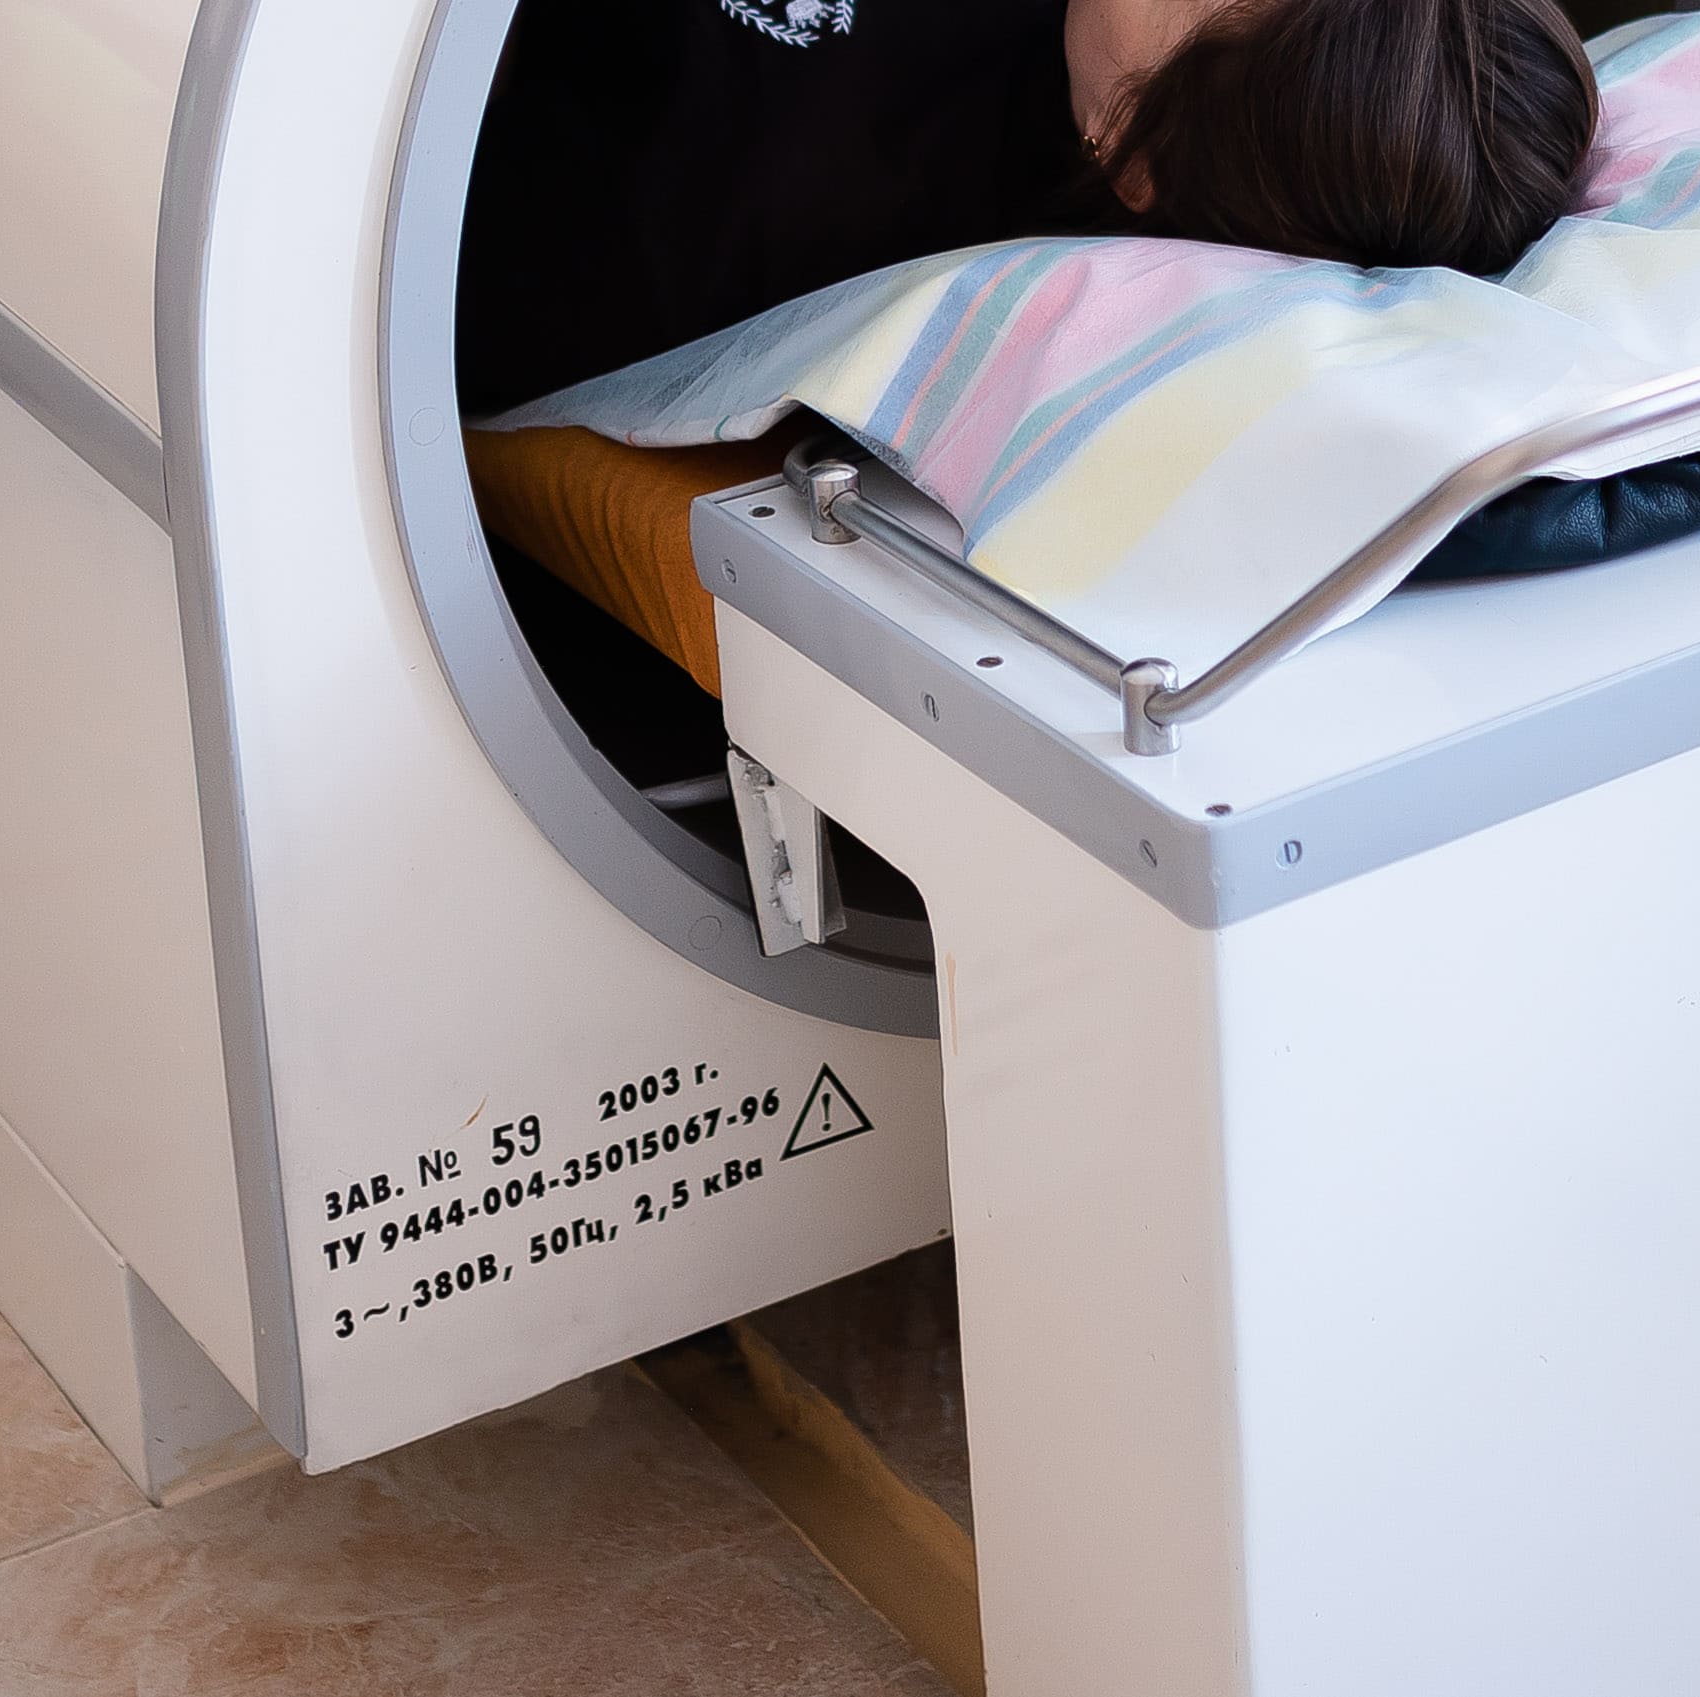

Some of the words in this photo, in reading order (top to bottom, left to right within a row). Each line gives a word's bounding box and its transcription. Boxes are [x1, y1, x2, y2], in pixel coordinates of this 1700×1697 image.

[322, 1230, 367, 1272] ТУ
[379, 1086, 781, 1254] 9444-004-35015067-96
[325, 1173, 405, 1222] ЗАВ.
[417, 1148, 462, 1188] №
[491, 1114, 542, 1166] 59
[598, 1066, 681, 1122] 2003
[693, 1062, 720, 1086] г.
[529, 1216, 619, 1265] 50Гц,
[633, 1178, 690, 1223] 2,5
[702, 1156, 764, 1198] кВа
